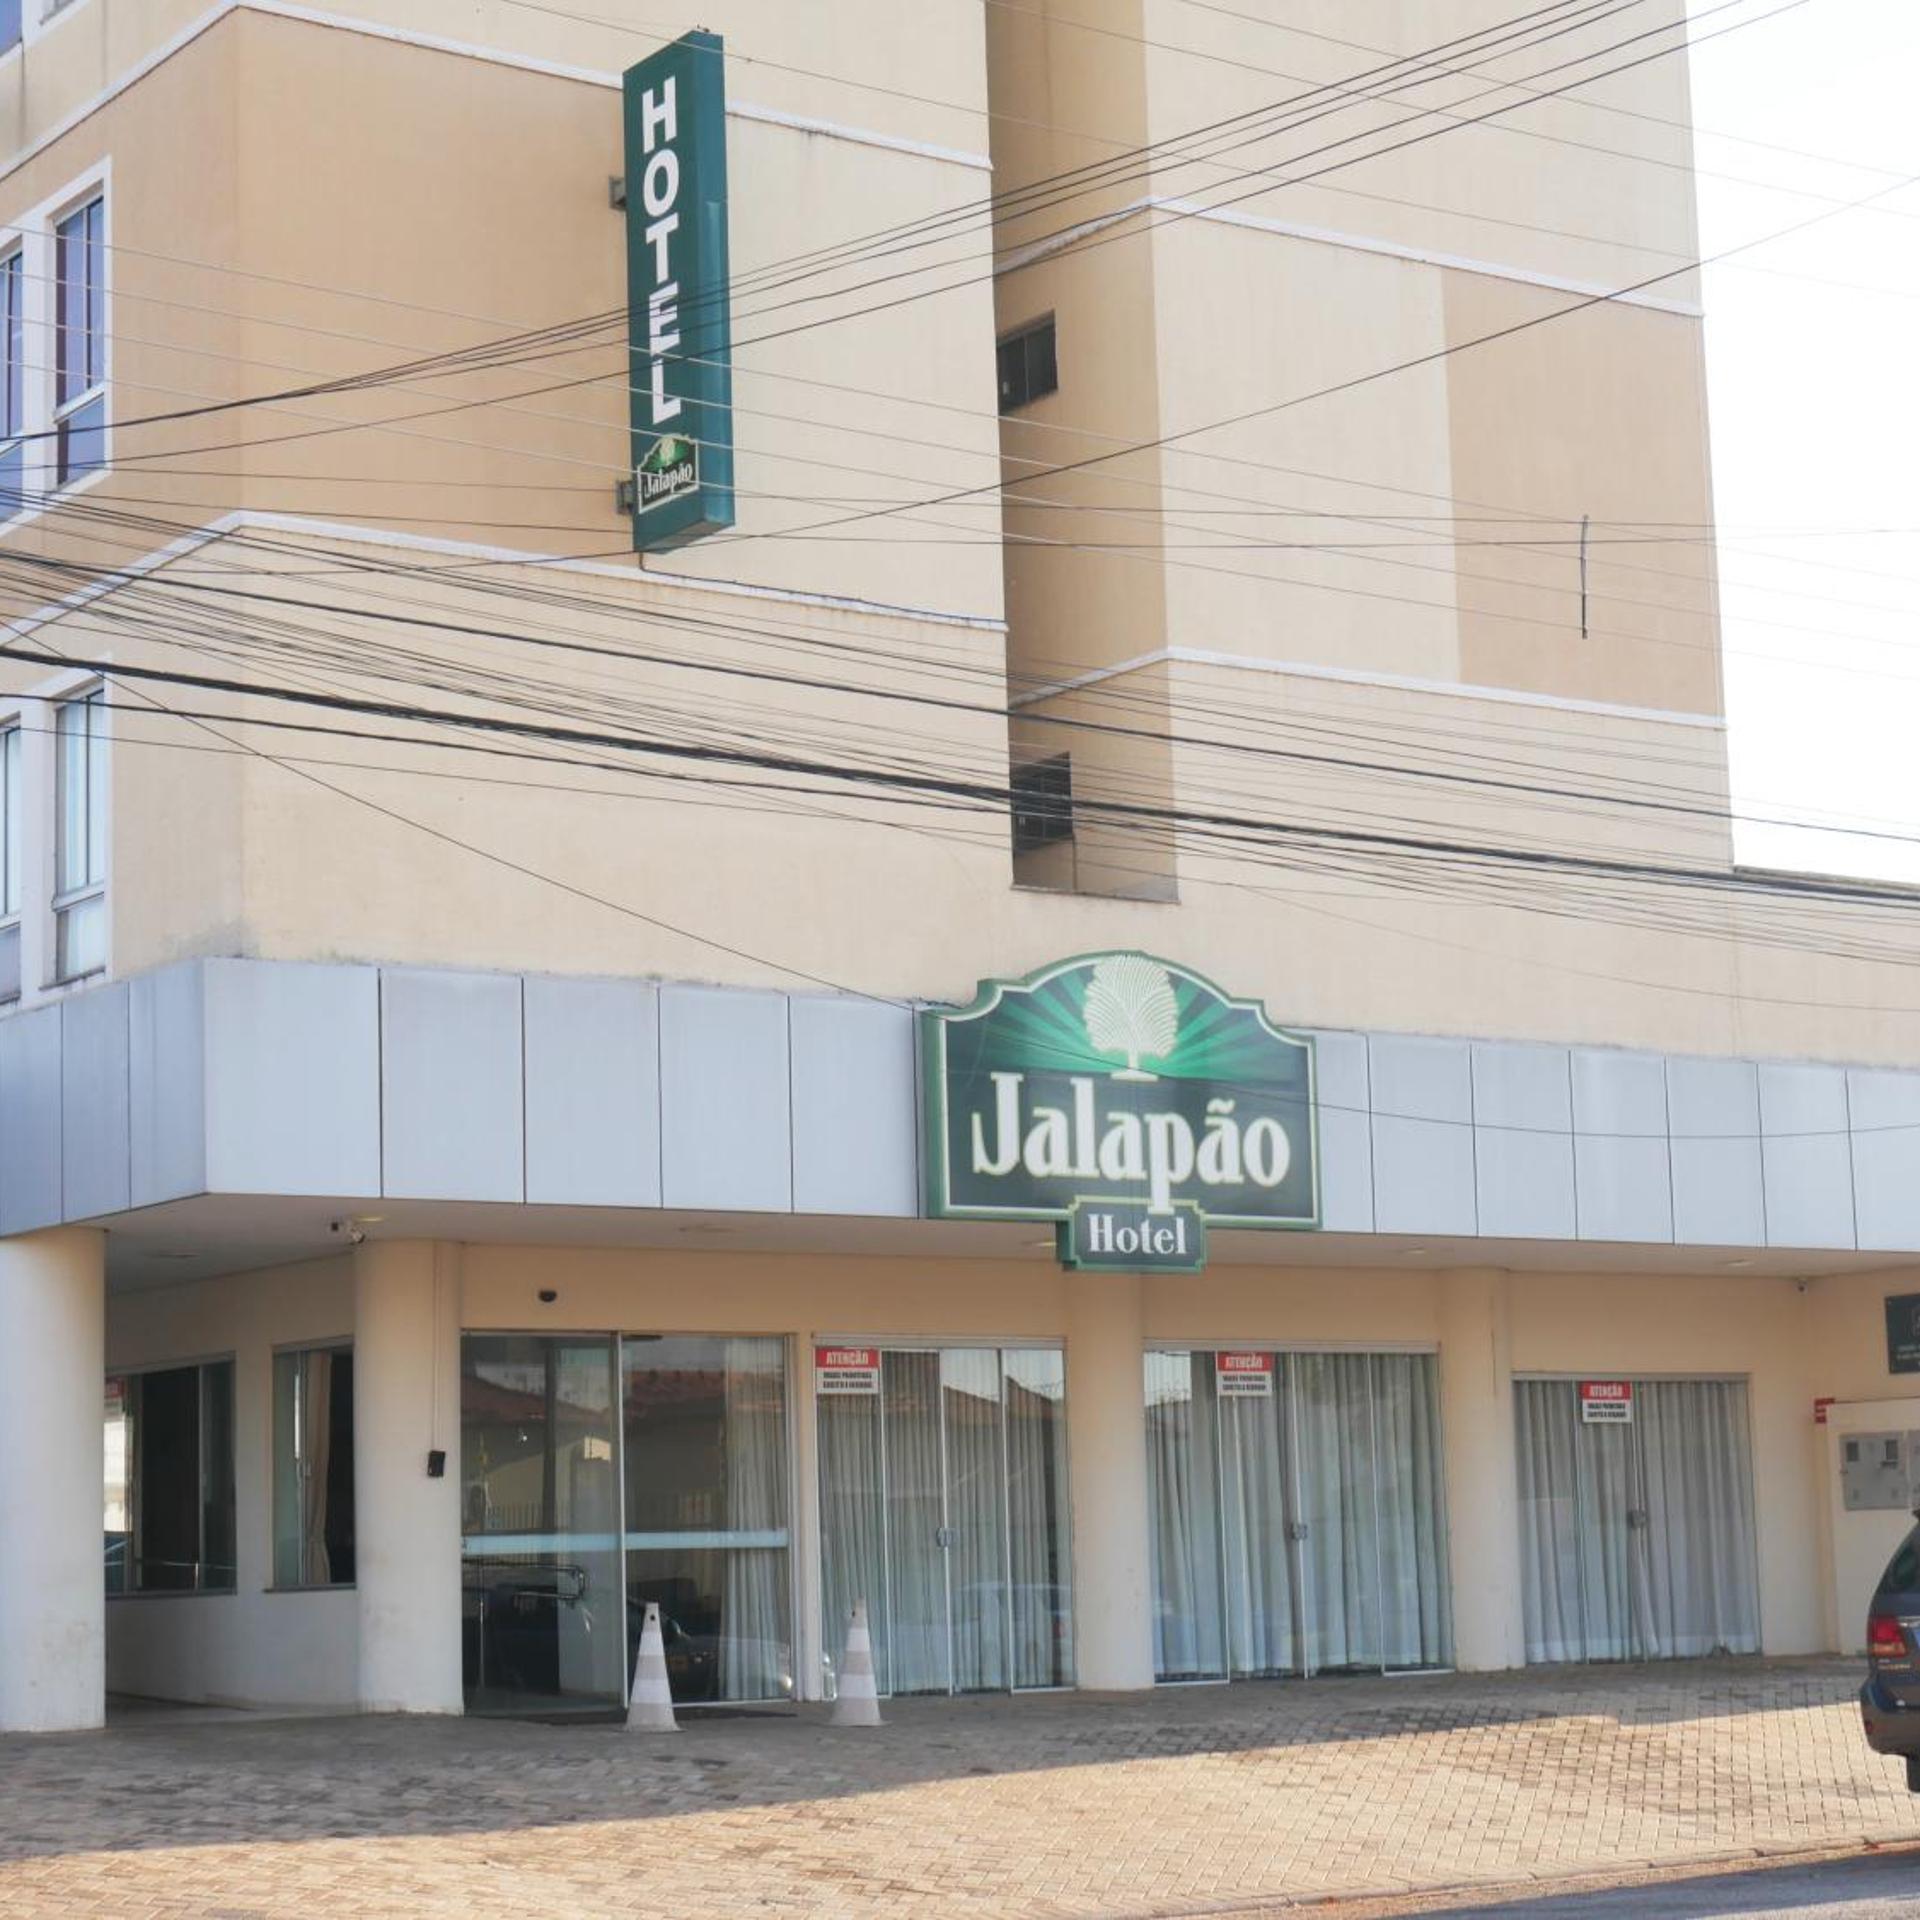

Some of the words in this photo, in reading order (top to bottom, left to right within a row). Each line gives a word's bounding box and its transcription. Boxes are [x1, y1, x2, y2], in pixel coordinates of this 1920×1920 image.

[641, 75, 682, 425] HOTEL
[971, 1071, 1291, 1215] Jalapão
[1087, 1213, 1187, 1255] Hotel
